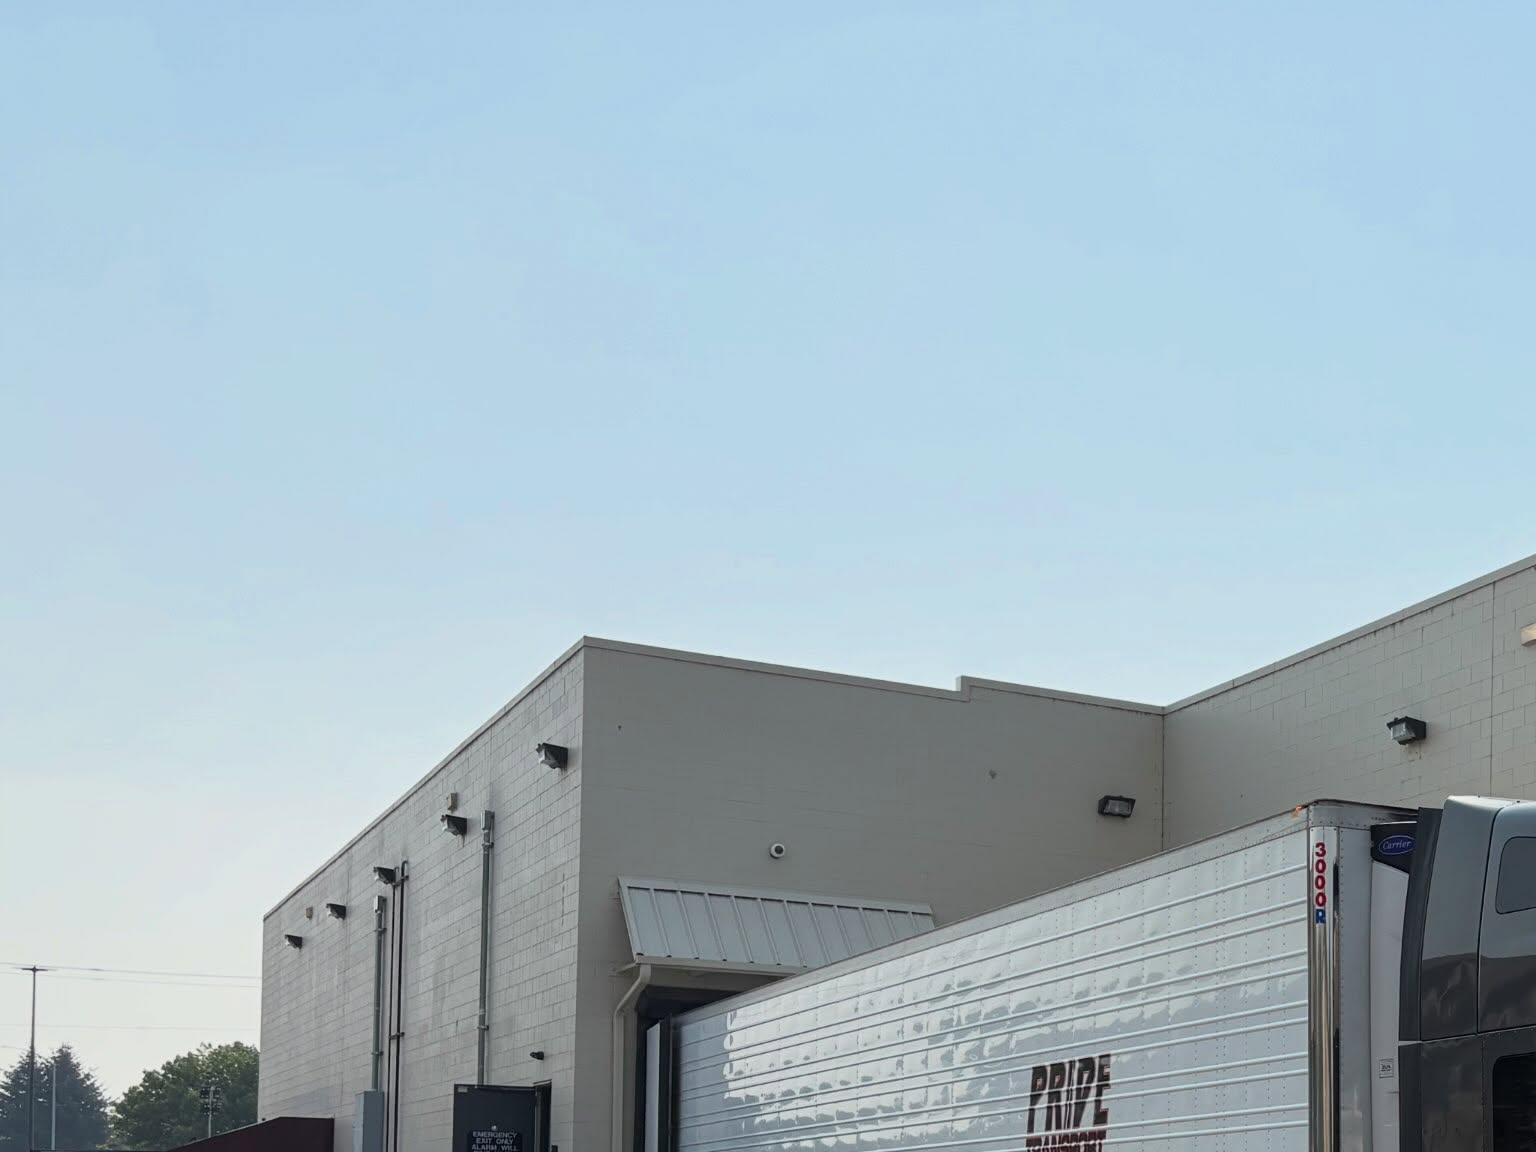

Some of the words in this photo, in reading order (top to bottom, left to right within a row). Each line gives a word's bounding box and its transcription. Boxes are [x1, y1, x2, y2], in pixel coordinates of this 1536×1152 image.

[1315, 842, 1327, 924] 3000R
[1383, 839, 1411, 851] Carrier
[1027, 1054, 1111, 1133] PRIDE
